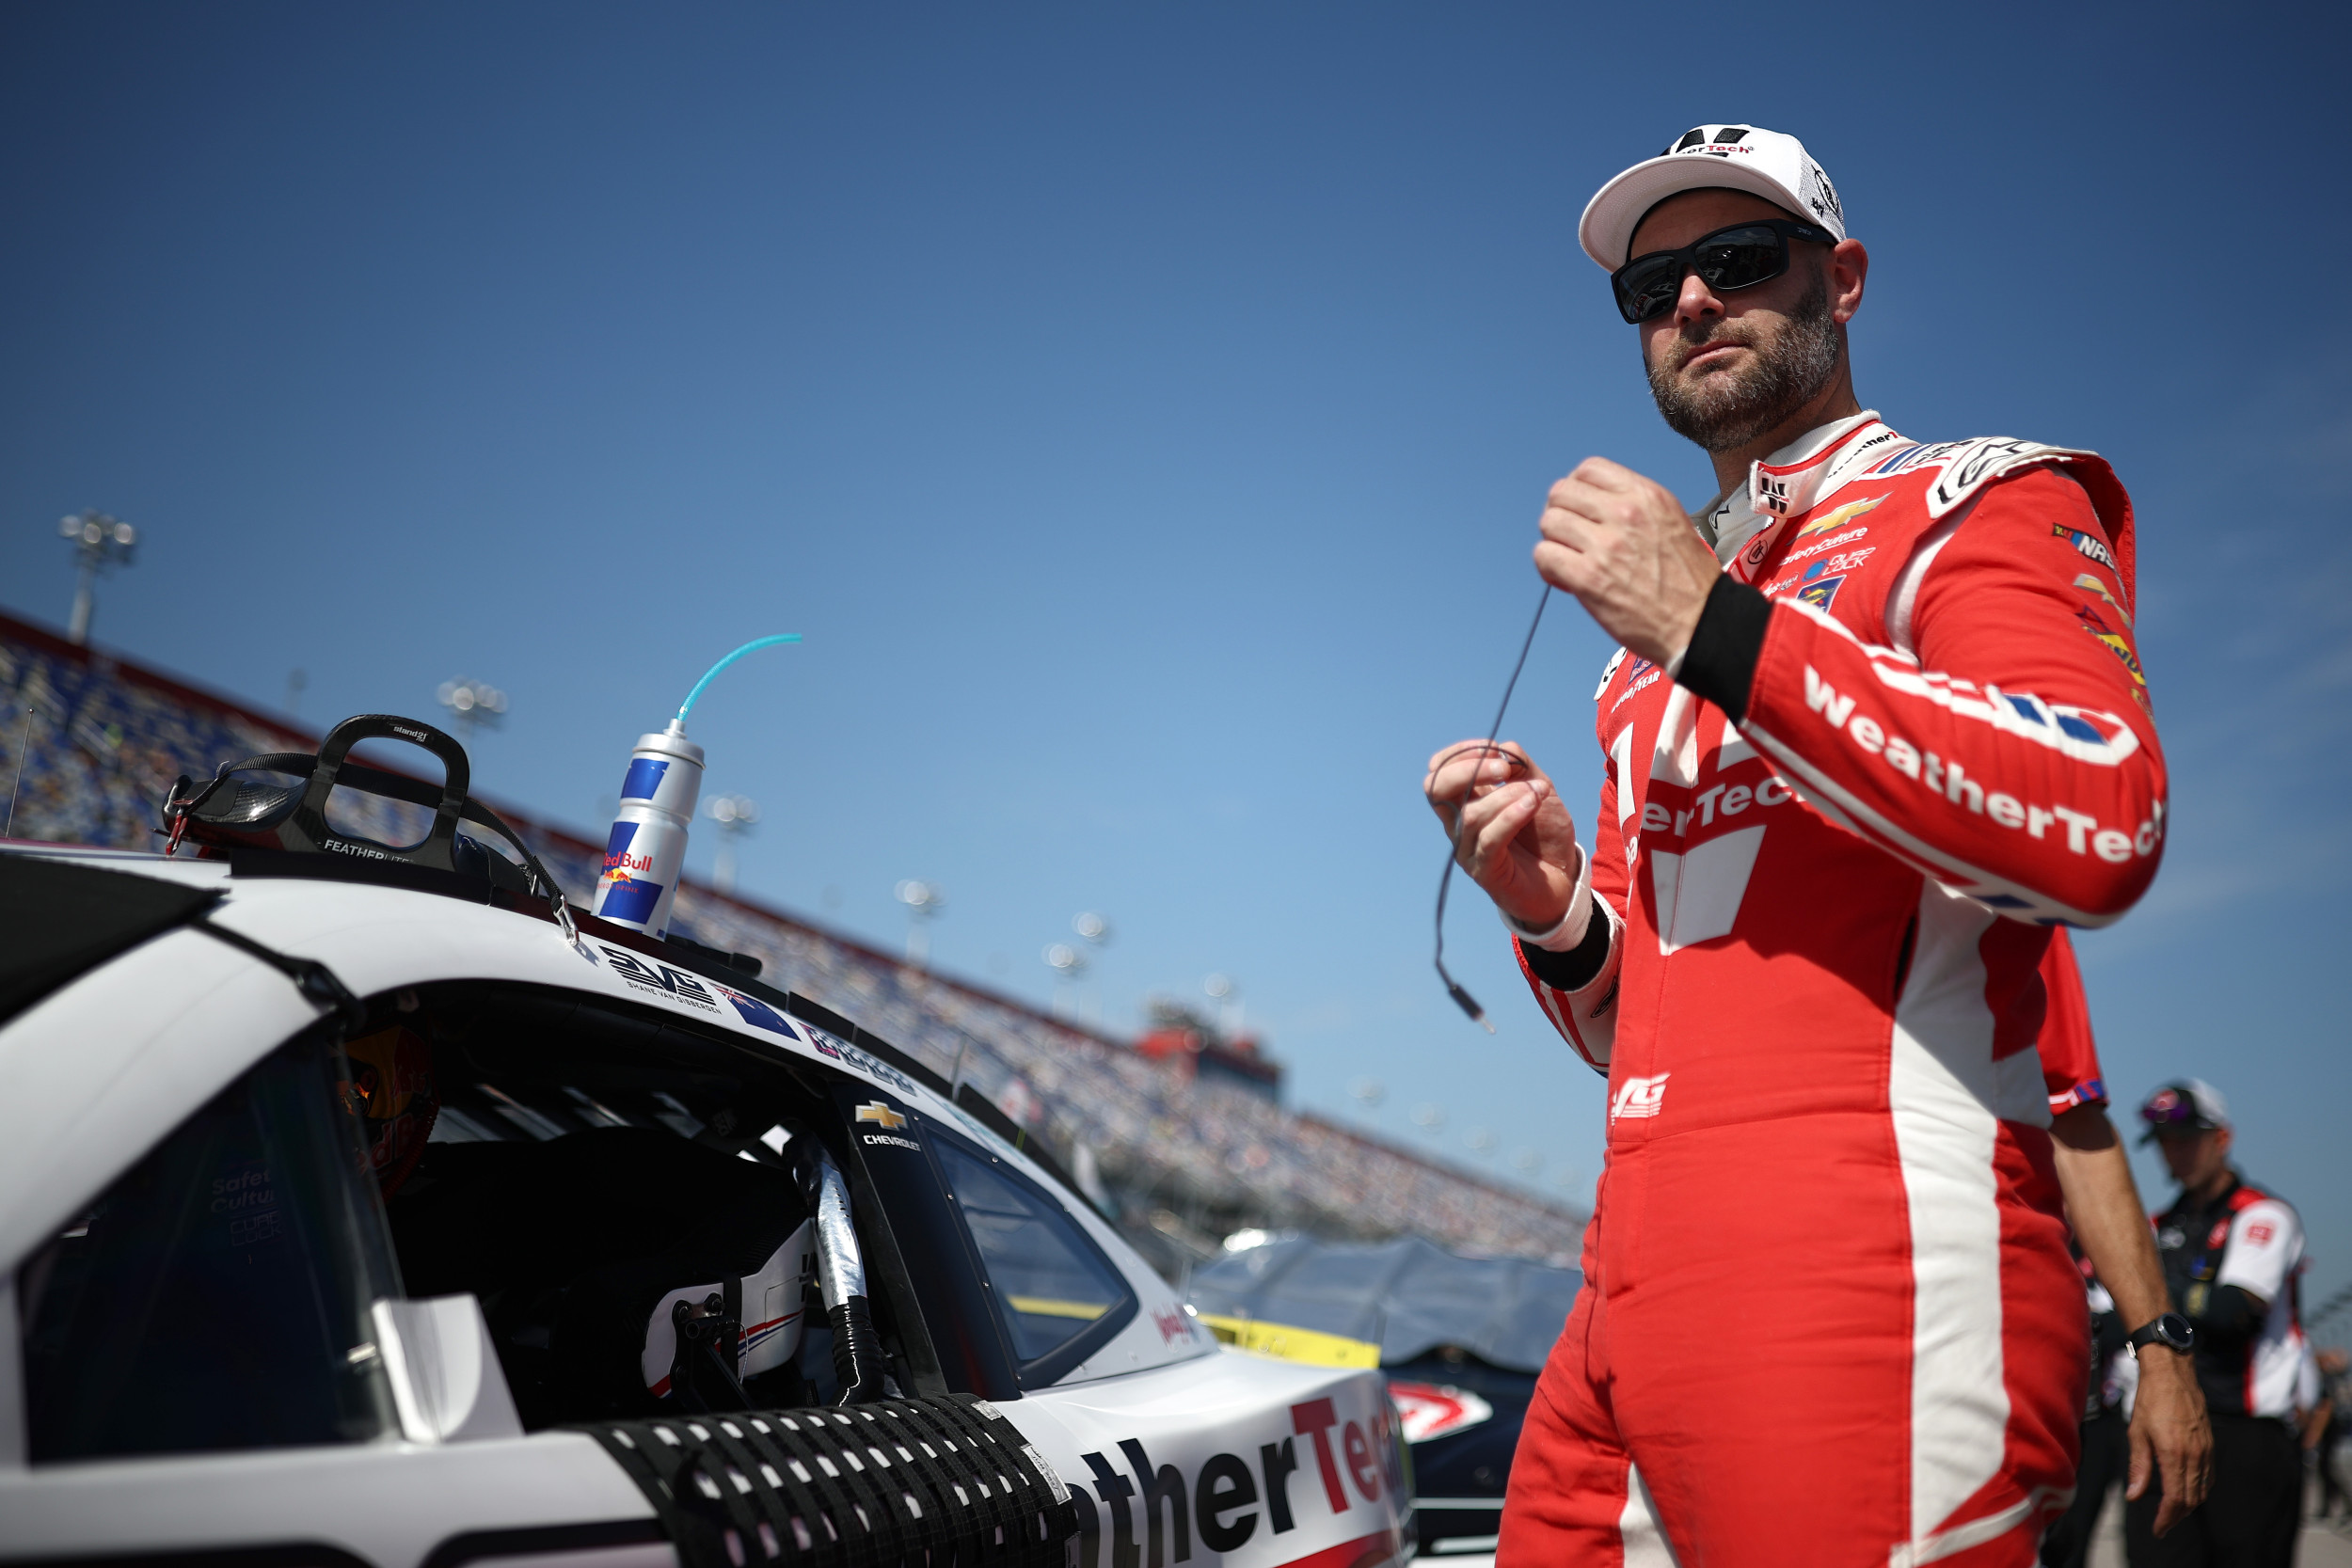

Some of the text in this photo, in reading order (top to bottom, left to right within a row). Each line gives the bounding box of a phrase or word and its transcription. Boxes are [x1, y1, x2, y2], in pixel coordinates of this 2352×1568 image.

[1679, 145, 1750, 154] erTech
[1778, 527, 1867, 566] afetyCulture
[1820, 555, 1868, 577] LOCK
[620, 852, 653, 873] Bull
[615, 884, 639, 894] DRINK
[657, 990, 675, 1002] VAN
[863, 1134, 922, 1152] CHEVROLET
[212, 1167, 272, 1196] Safet
